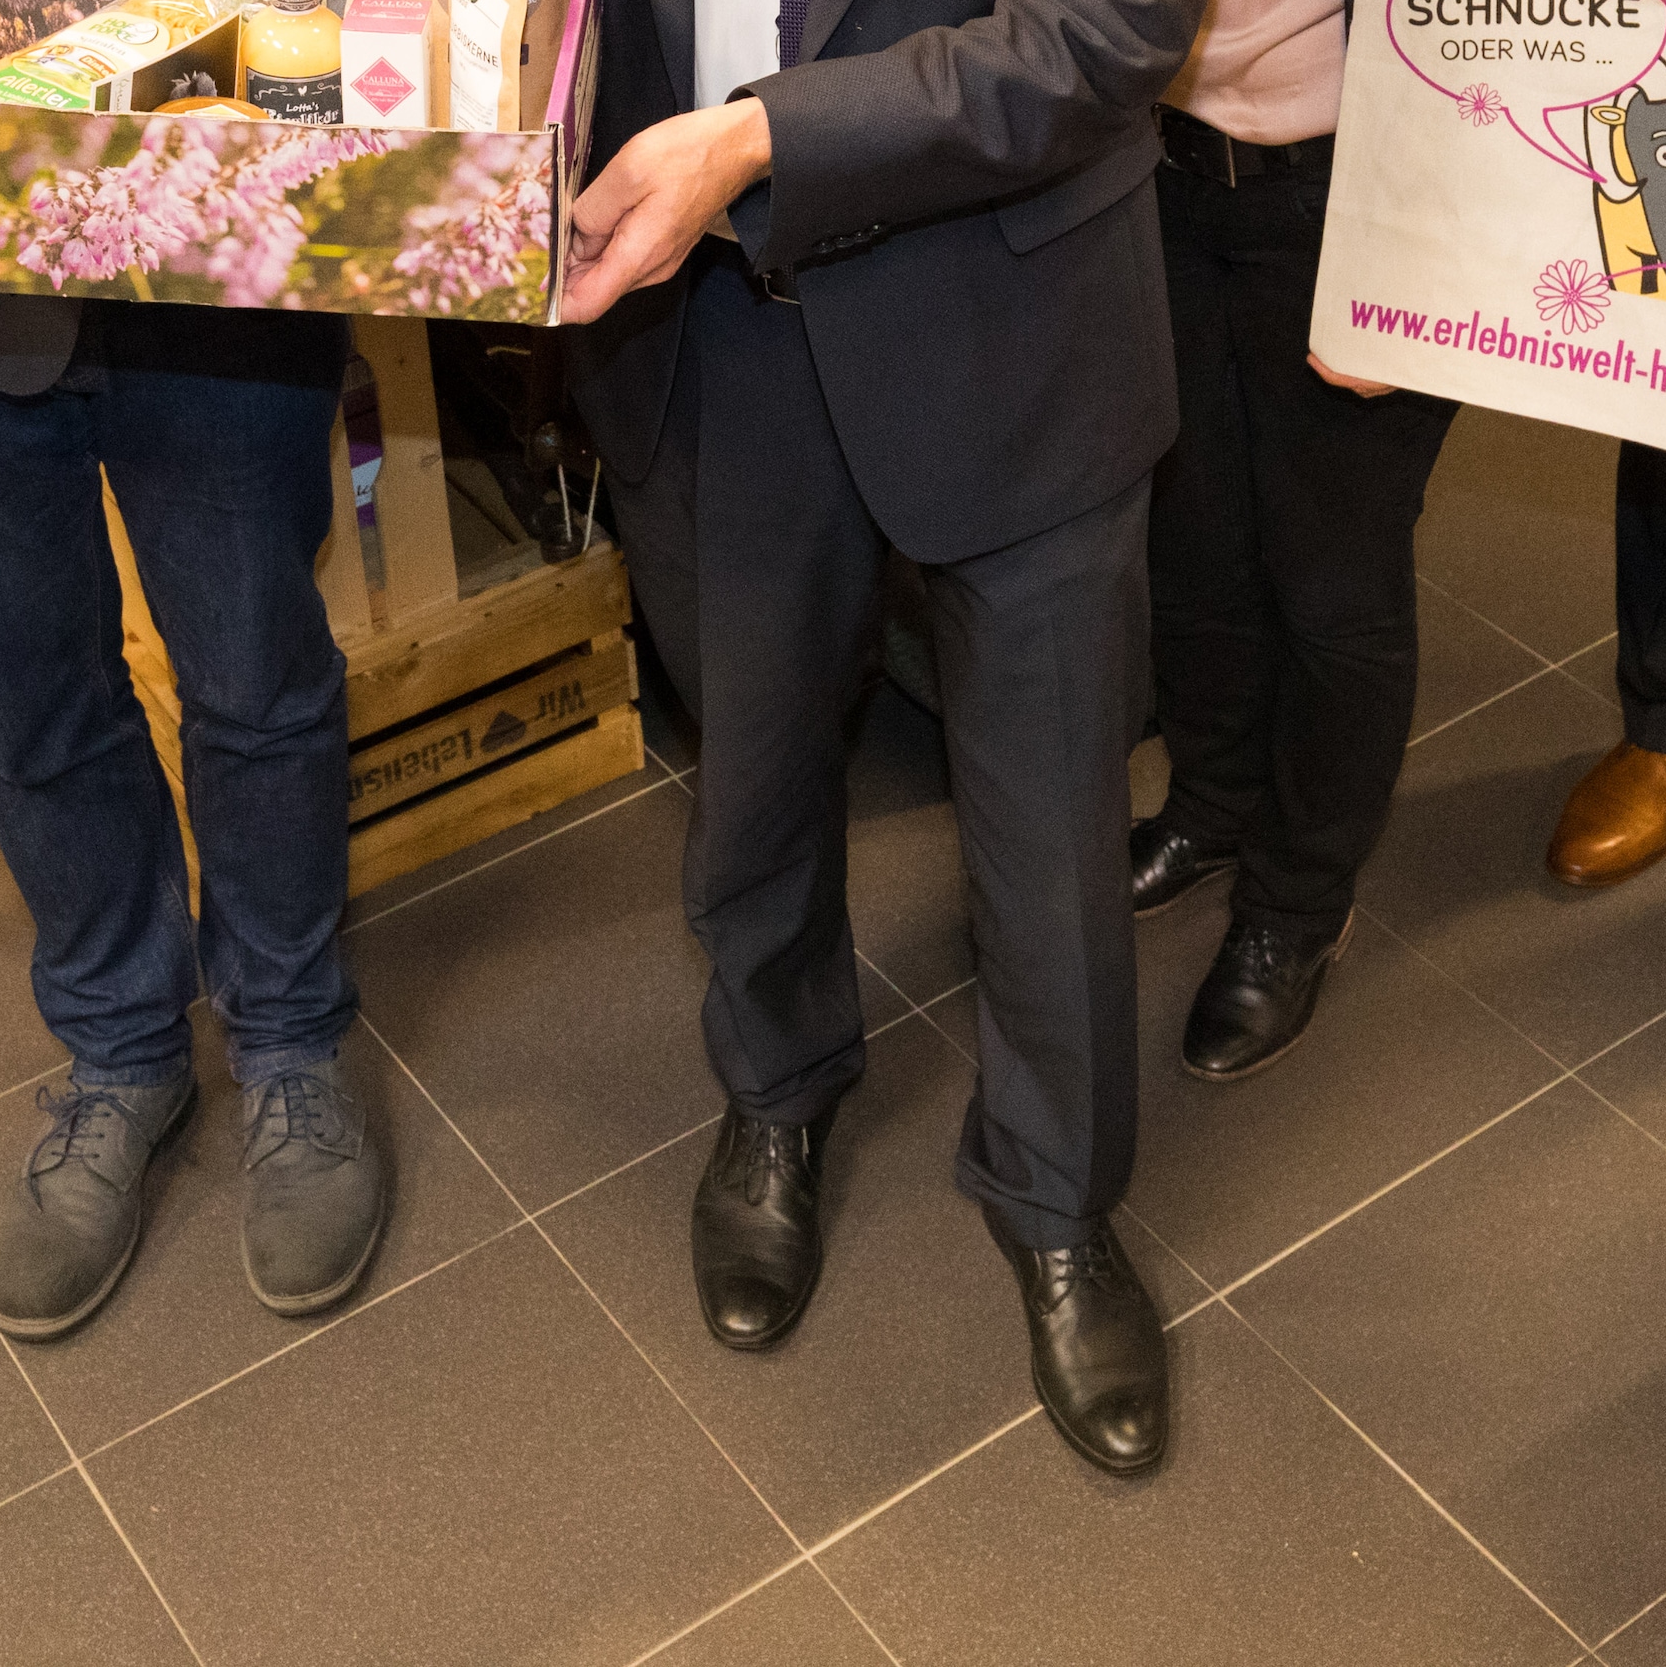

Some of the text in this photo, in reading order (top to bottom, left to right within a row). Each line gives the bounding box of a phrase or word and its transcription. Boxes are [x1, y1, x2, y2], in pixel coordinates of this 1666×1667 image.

[1440, 38, 1514, 61] ODER
[1523, 38, 1586, 63] WAS
[361, 74, 405, 86] CALLUNA
[285, 102, 320, 113] Lotta's
[532, 680, 586, 723] Wir
